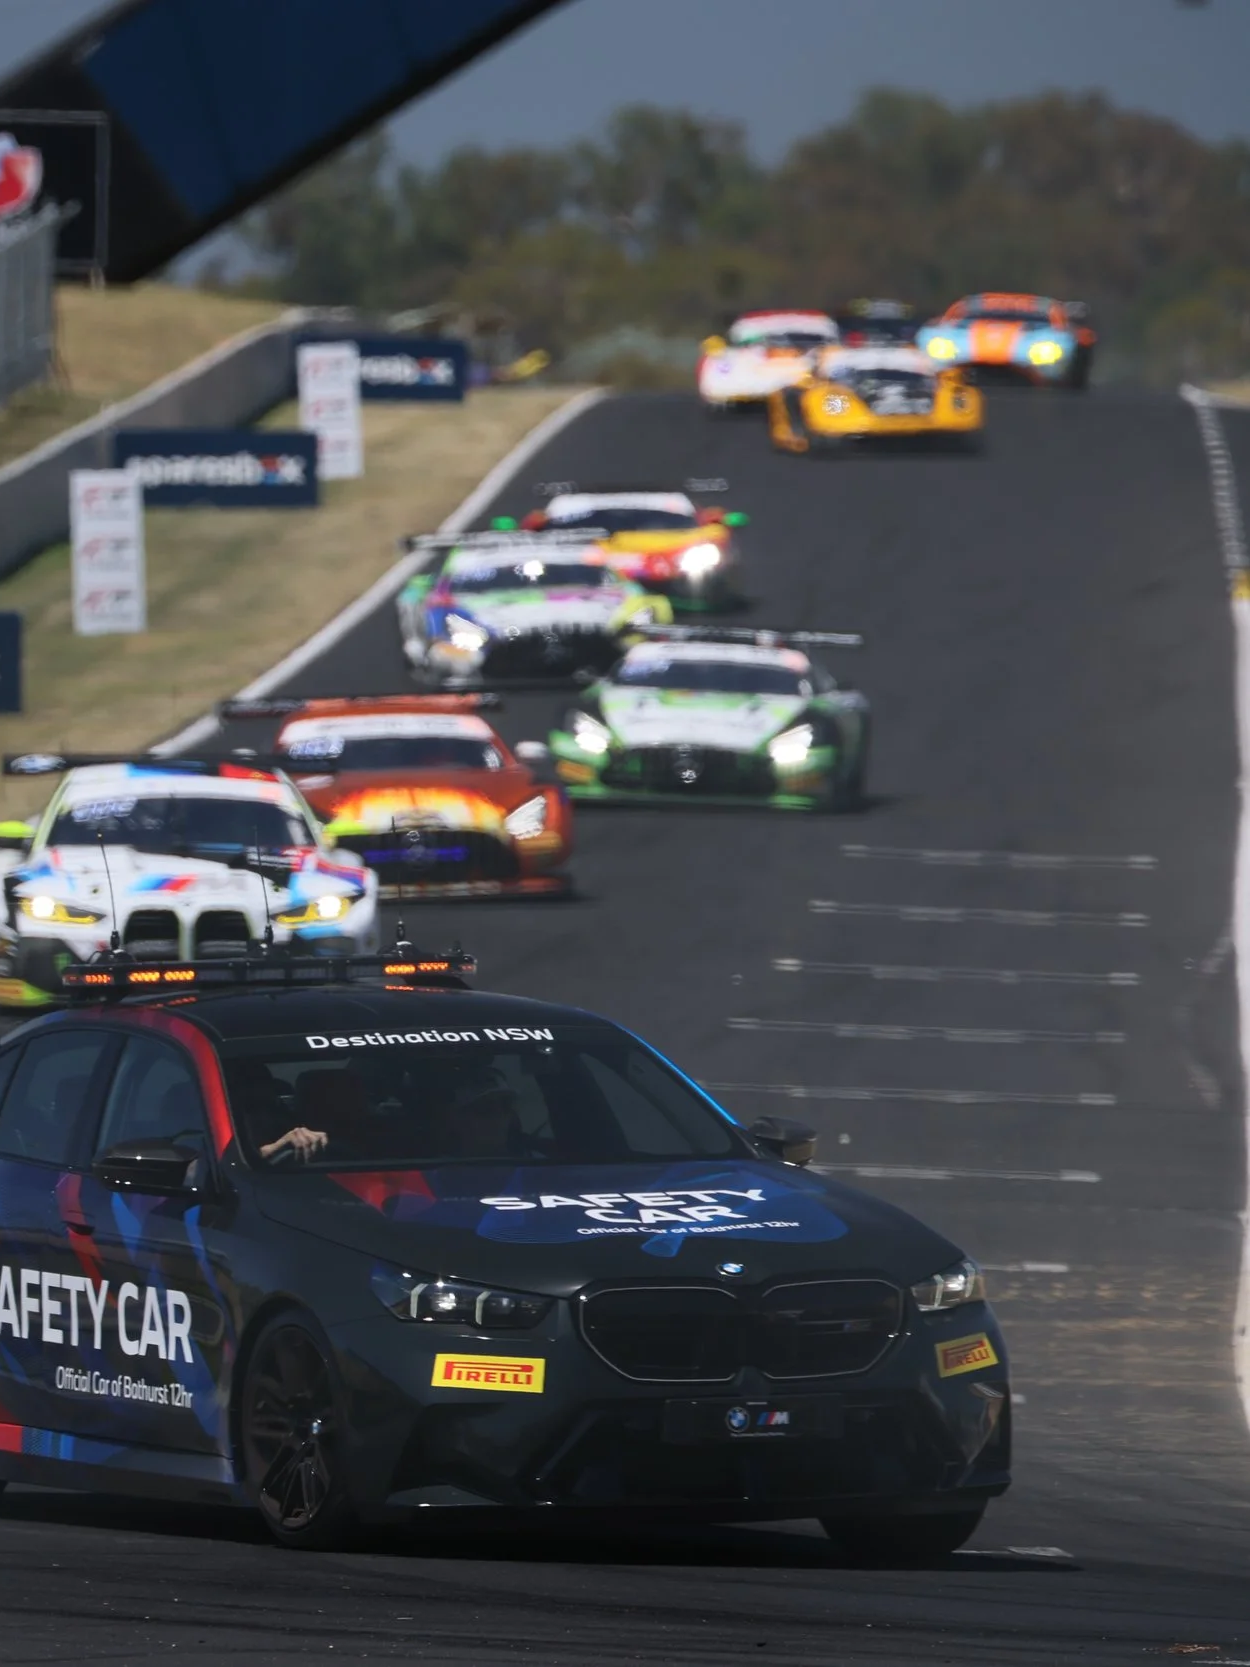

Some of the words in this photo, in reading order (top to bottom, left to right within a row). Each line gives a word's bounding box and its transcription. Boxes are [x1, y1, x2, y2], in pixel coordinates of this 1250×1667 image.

[305, 1030, 480, 1049] Destination
[483, 1028, 554, 1042] NSW
[480, 1189, 767, 1211] SAFETY
[584, 1205, 748, 1225] CAR
[577, 1226, 638, 1235] Official
[638, 1226, 668, 1234] Car
[688, 1222, 762, 1233] Bathurst
[763, 1220, 800, 1228] 12hr
[117, 1281, 194, 1364] CAR
[443, 1360, 535, 1386] PIRELLI
[56, 1365, 91, 1393] Official
[92, 1370, 110, 1395] Car
[111, 1374, 123, 1397] of
[123, 1375, 169, 1405] Bathurst
[169, 1382, 193, 1409] 12hr
